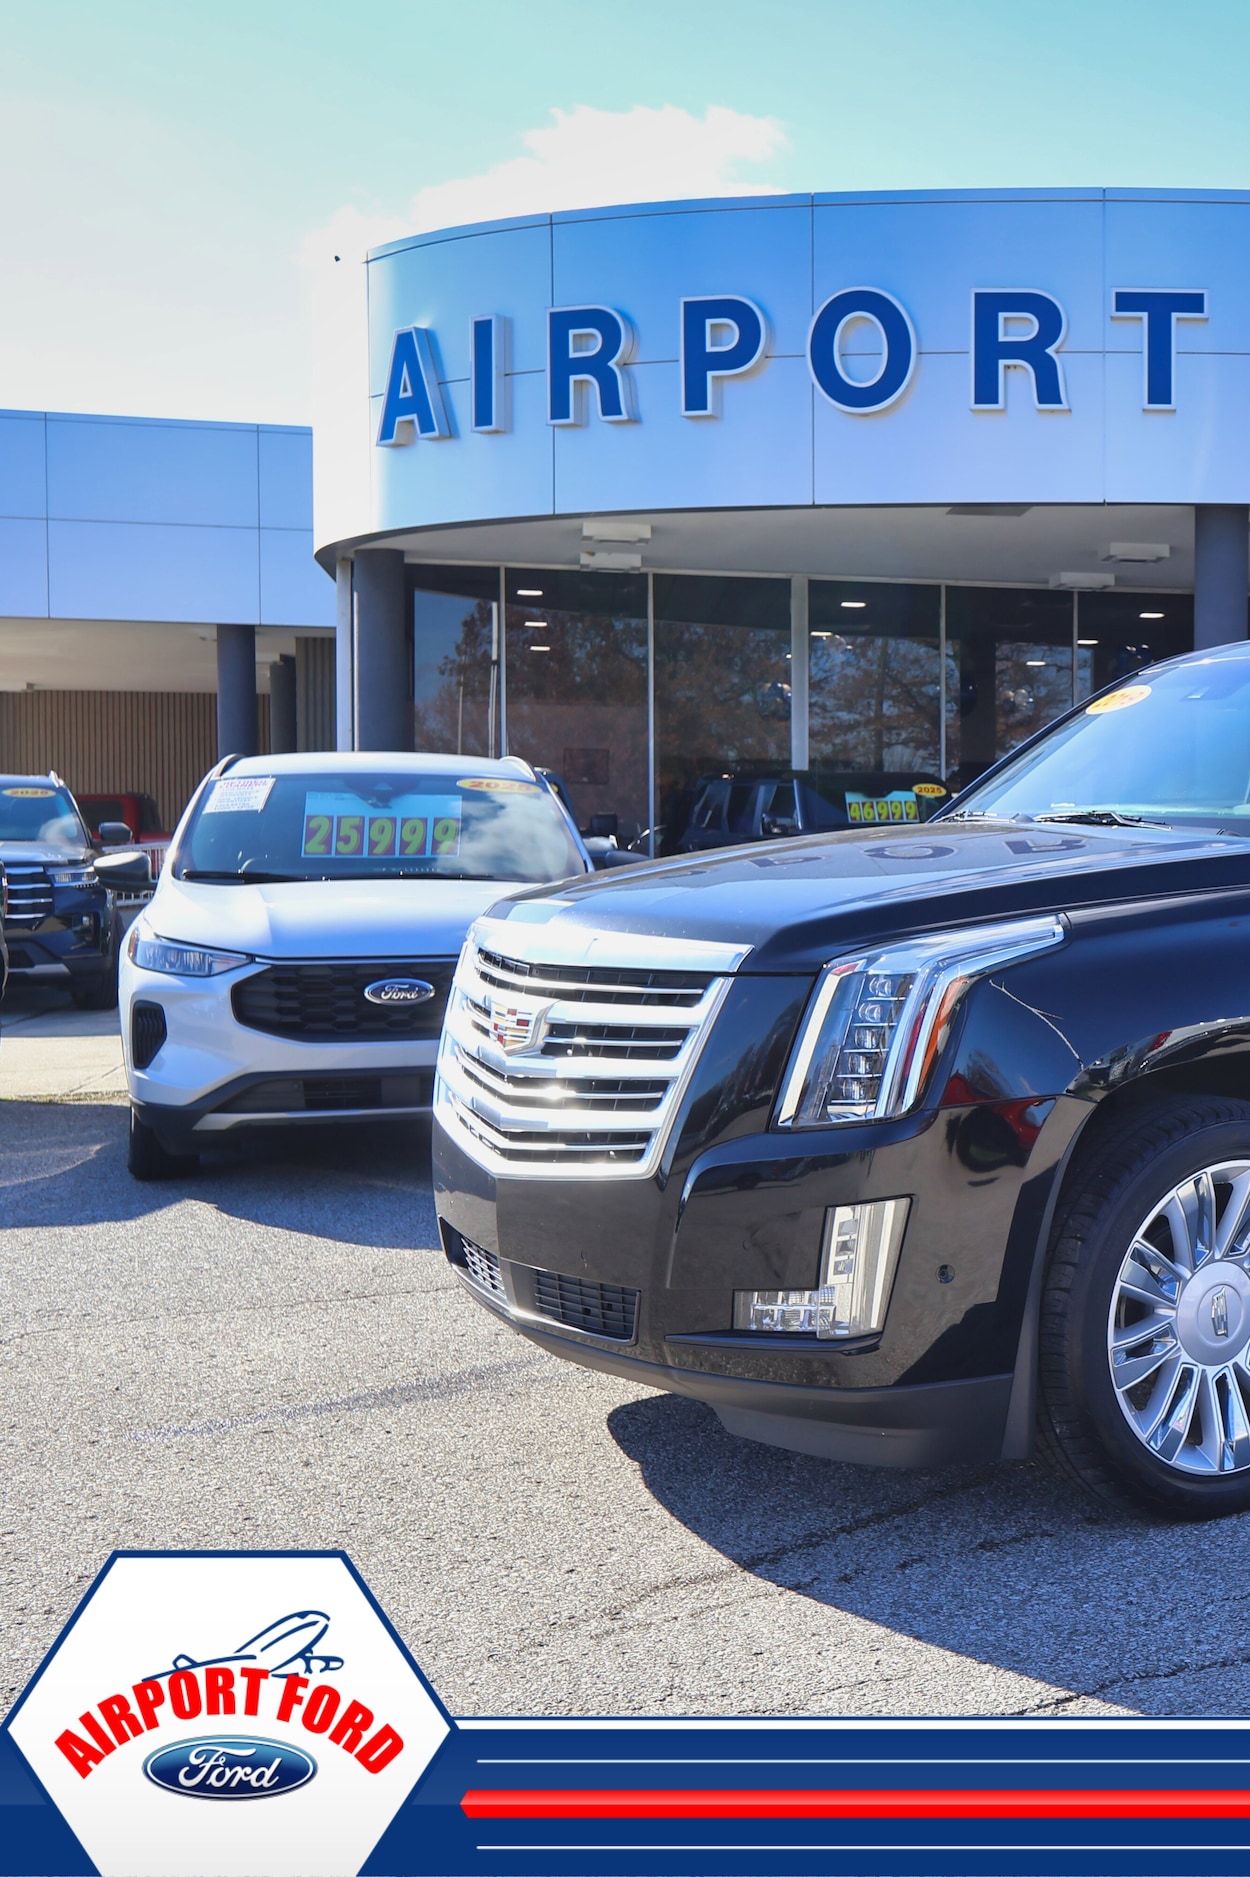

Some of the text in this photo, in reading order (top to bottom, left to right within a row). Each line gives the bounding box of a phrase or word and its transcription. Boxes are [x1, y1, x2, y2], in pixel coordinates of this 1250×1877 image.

[376, 285, 1209, 446] AIRPORT
[469, 781, 533, 791] 2025
[917, 785, 943, 794] 2025
[850, 801, 916, 821] 46999
[305, 815, 458, 855] 25999
[381, 984, 418, 999] Ford
